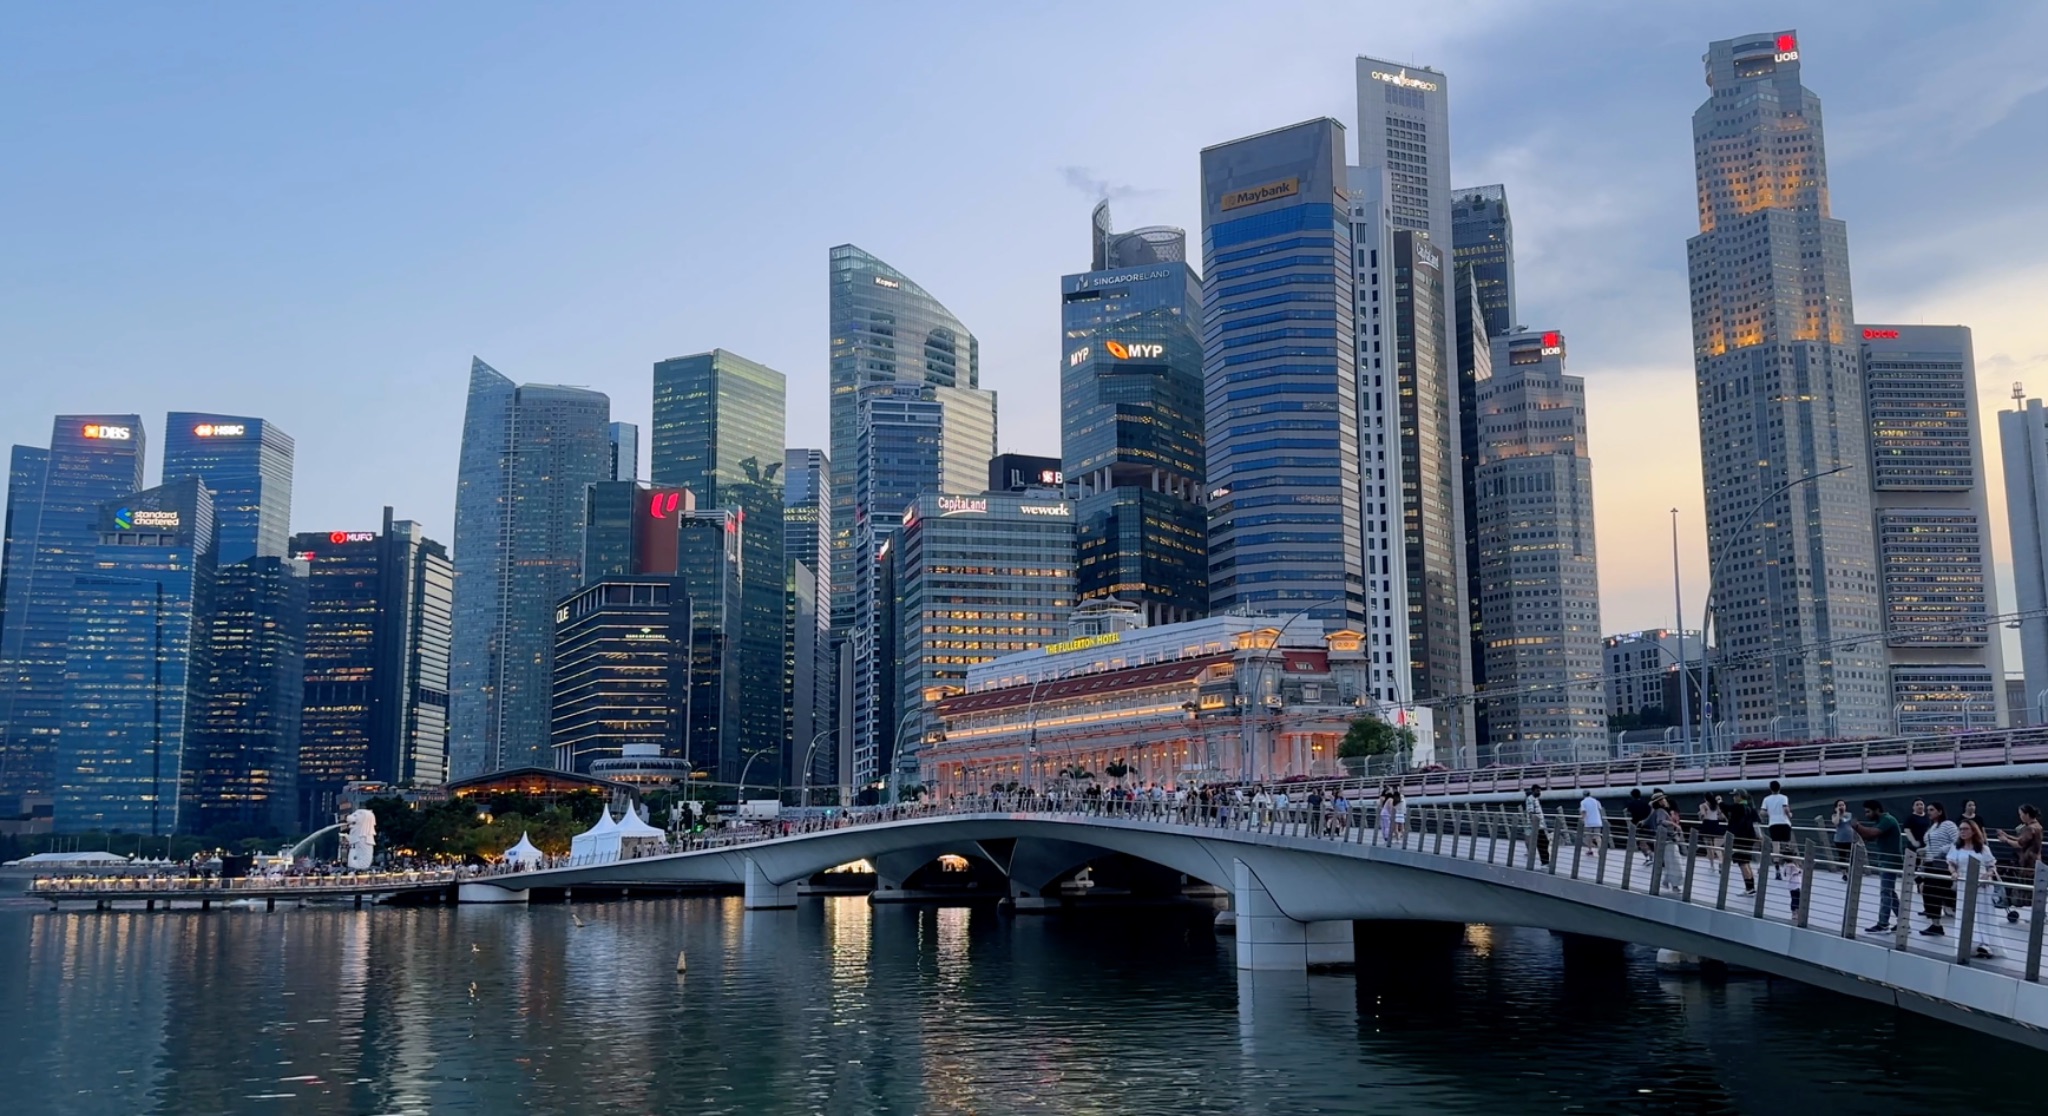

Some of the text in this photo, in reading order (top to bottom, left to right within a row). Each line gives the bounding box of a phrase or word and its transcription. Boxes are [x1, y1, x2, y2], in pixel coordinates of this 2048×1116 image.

[1774, 51, 1798, 63] UOB
[1237, 182, 1291, 204] Maybank
[1070, 347, 1090, 367] MYP
[1128, 343, 1163, 358] MYP
[1541, 346, 1561, 356] UOB
[99, 425, 130, 440] DBS
[214, 424, 245, 436] HSBC
[938, 496, 986, 511] CapitaLand
[1020, 503, 1070, 516] wework
[133, 510, 178, 519] standard
[133, 518, 179, 526] chartered
[346, 533, 374, 542] MUFG
[1045, 631, 1121, 656] THE FULLERTON HOTEL
